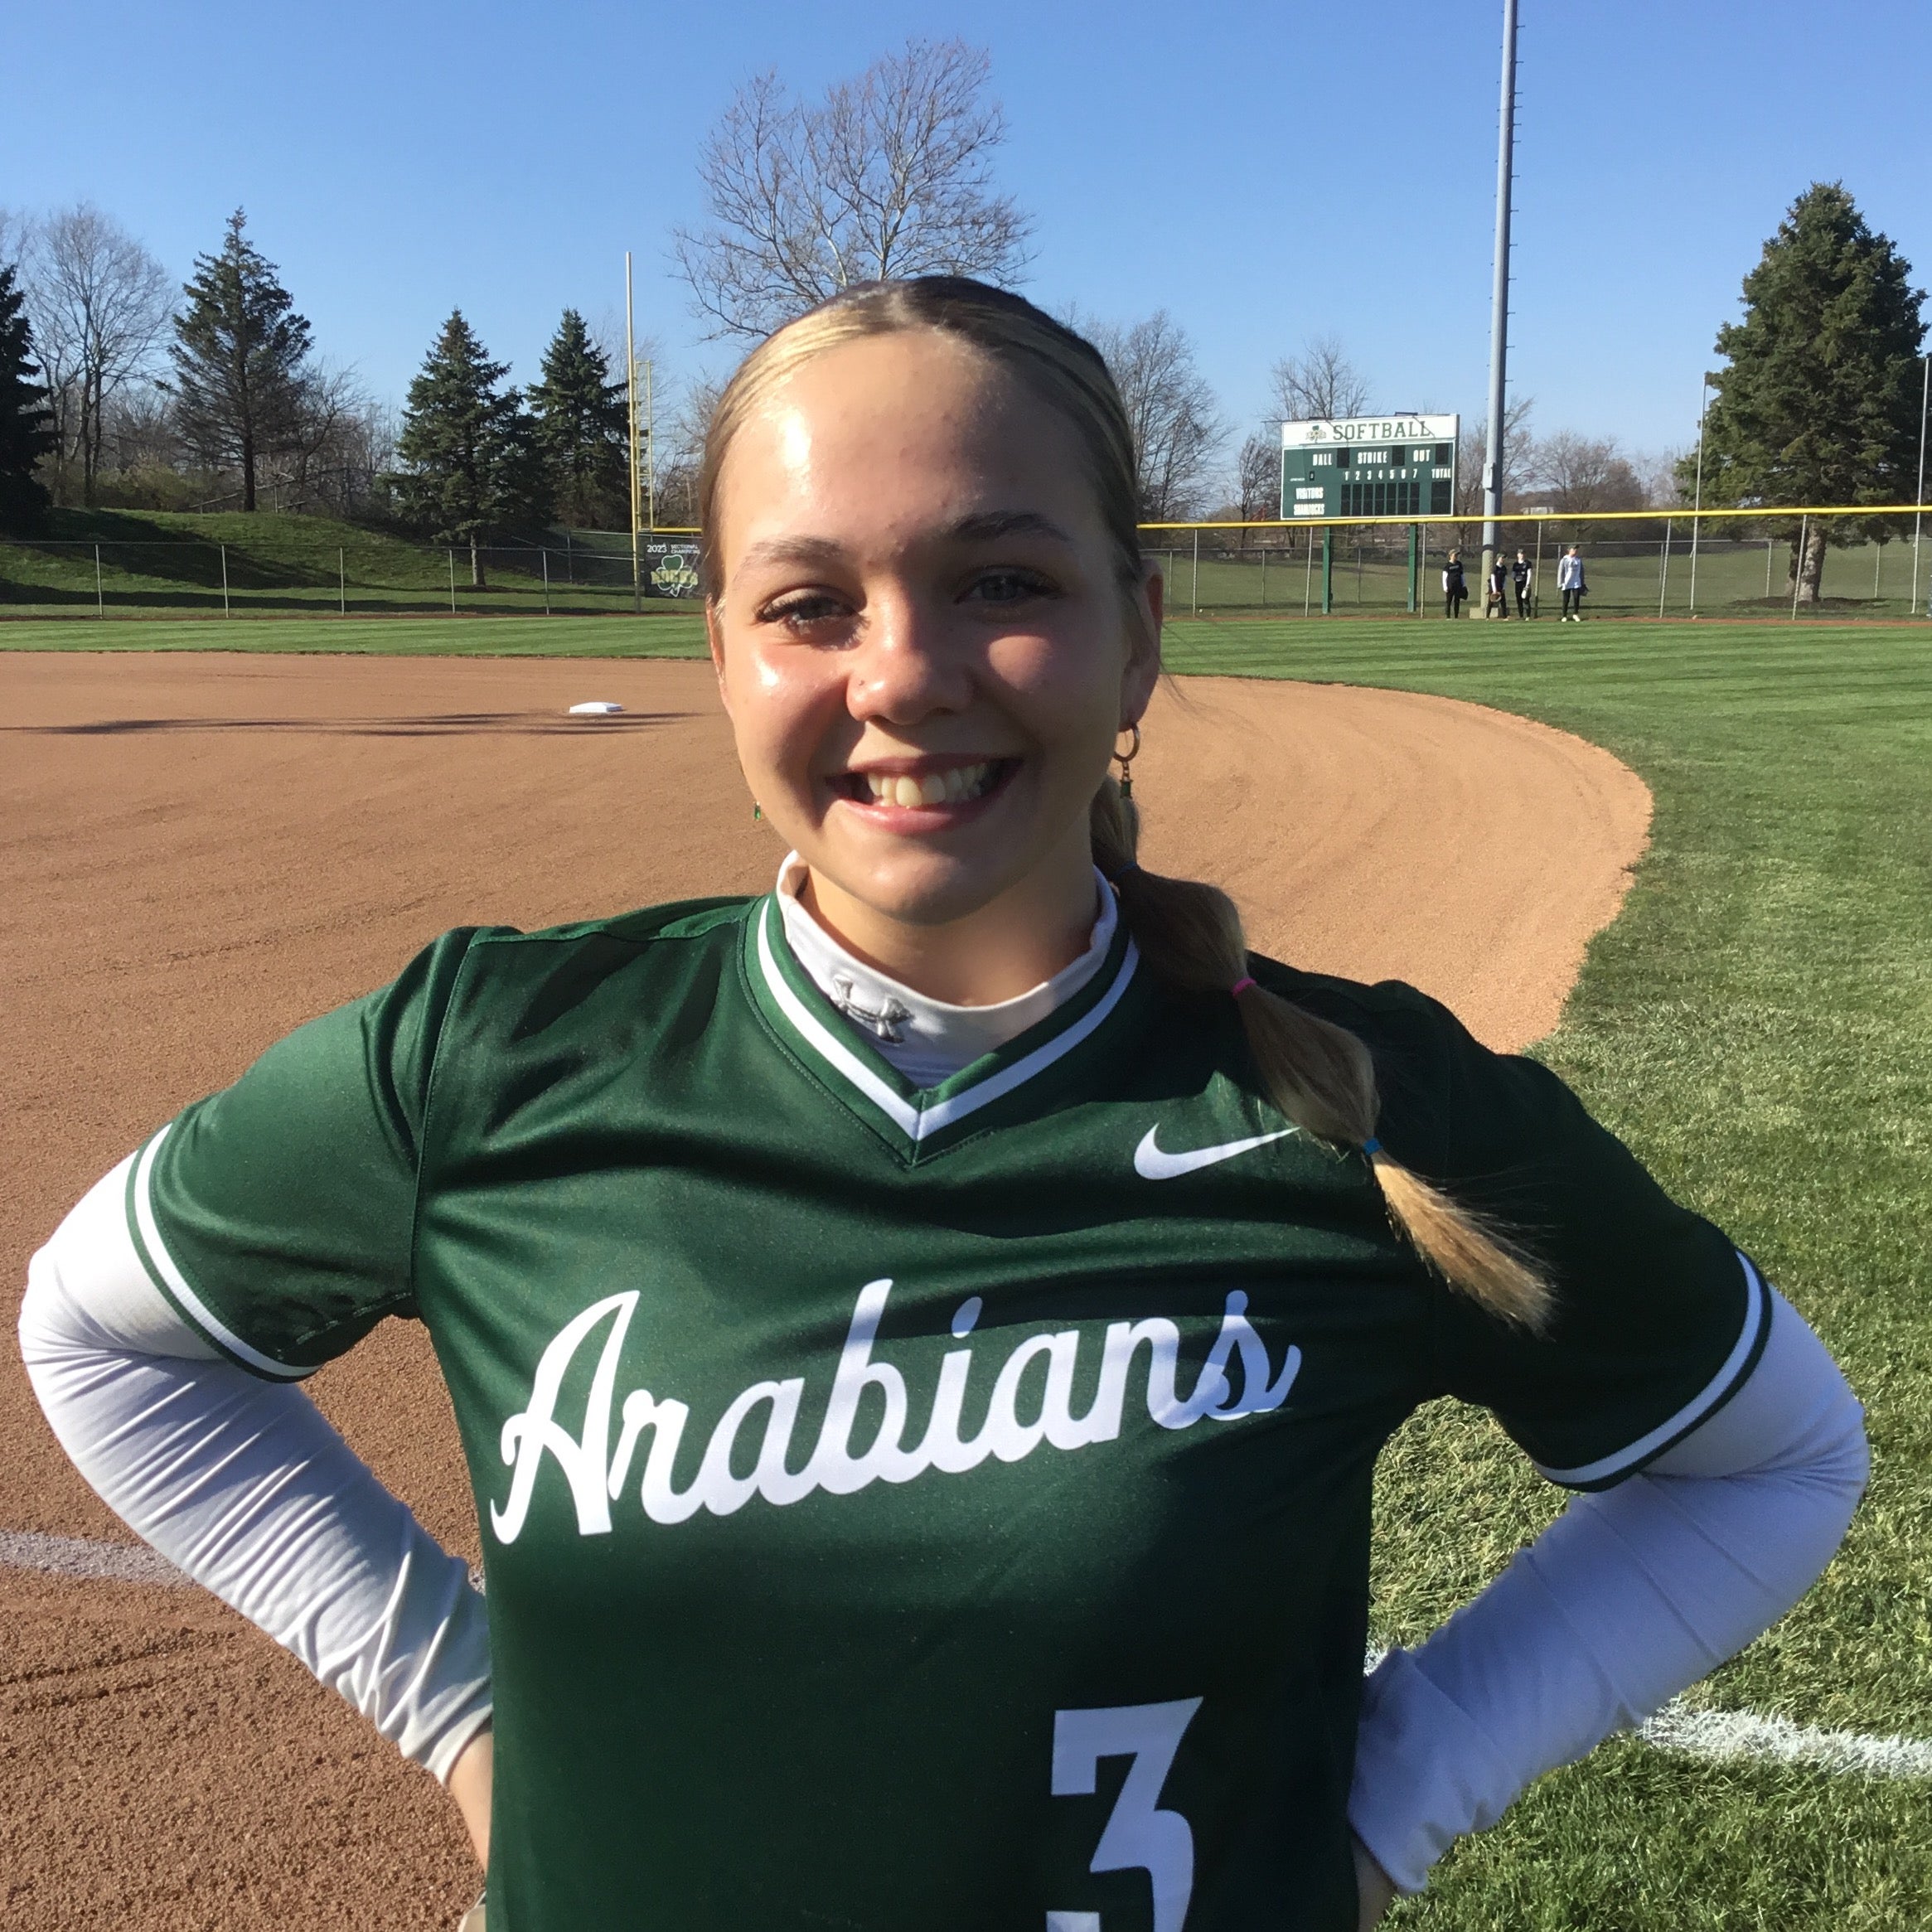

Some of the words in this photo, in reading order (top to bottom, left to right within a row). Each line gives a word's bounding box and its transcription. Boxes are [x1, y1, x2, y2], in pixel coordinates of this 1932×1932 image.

[1333, 421, 1431, 441] SOFTBALL
[1313, 453, 1332, 466] BALL
[1358, 451, 1387, 464] STRIKE
[1413, 449, 1431, 462] OUT
[1344, 471, 1349, 481] 1
[1355, 471, 1360, 481] 2
[1367, 470, 1372, 481] 3
[1378, 469, 1383, 480] 4
[1389, 468, 1395, 479] 5
[1401, 468, 1406, 479] 6
[1412, 468, 1417, 478] 7
[1431, 468, 1451, 479] TOTAL
[1295, 487, 1324, 500] VISITORS
[491, 1278, 1302, 1544] Arabians
[1046, 1696, 1204, 1932] 3
